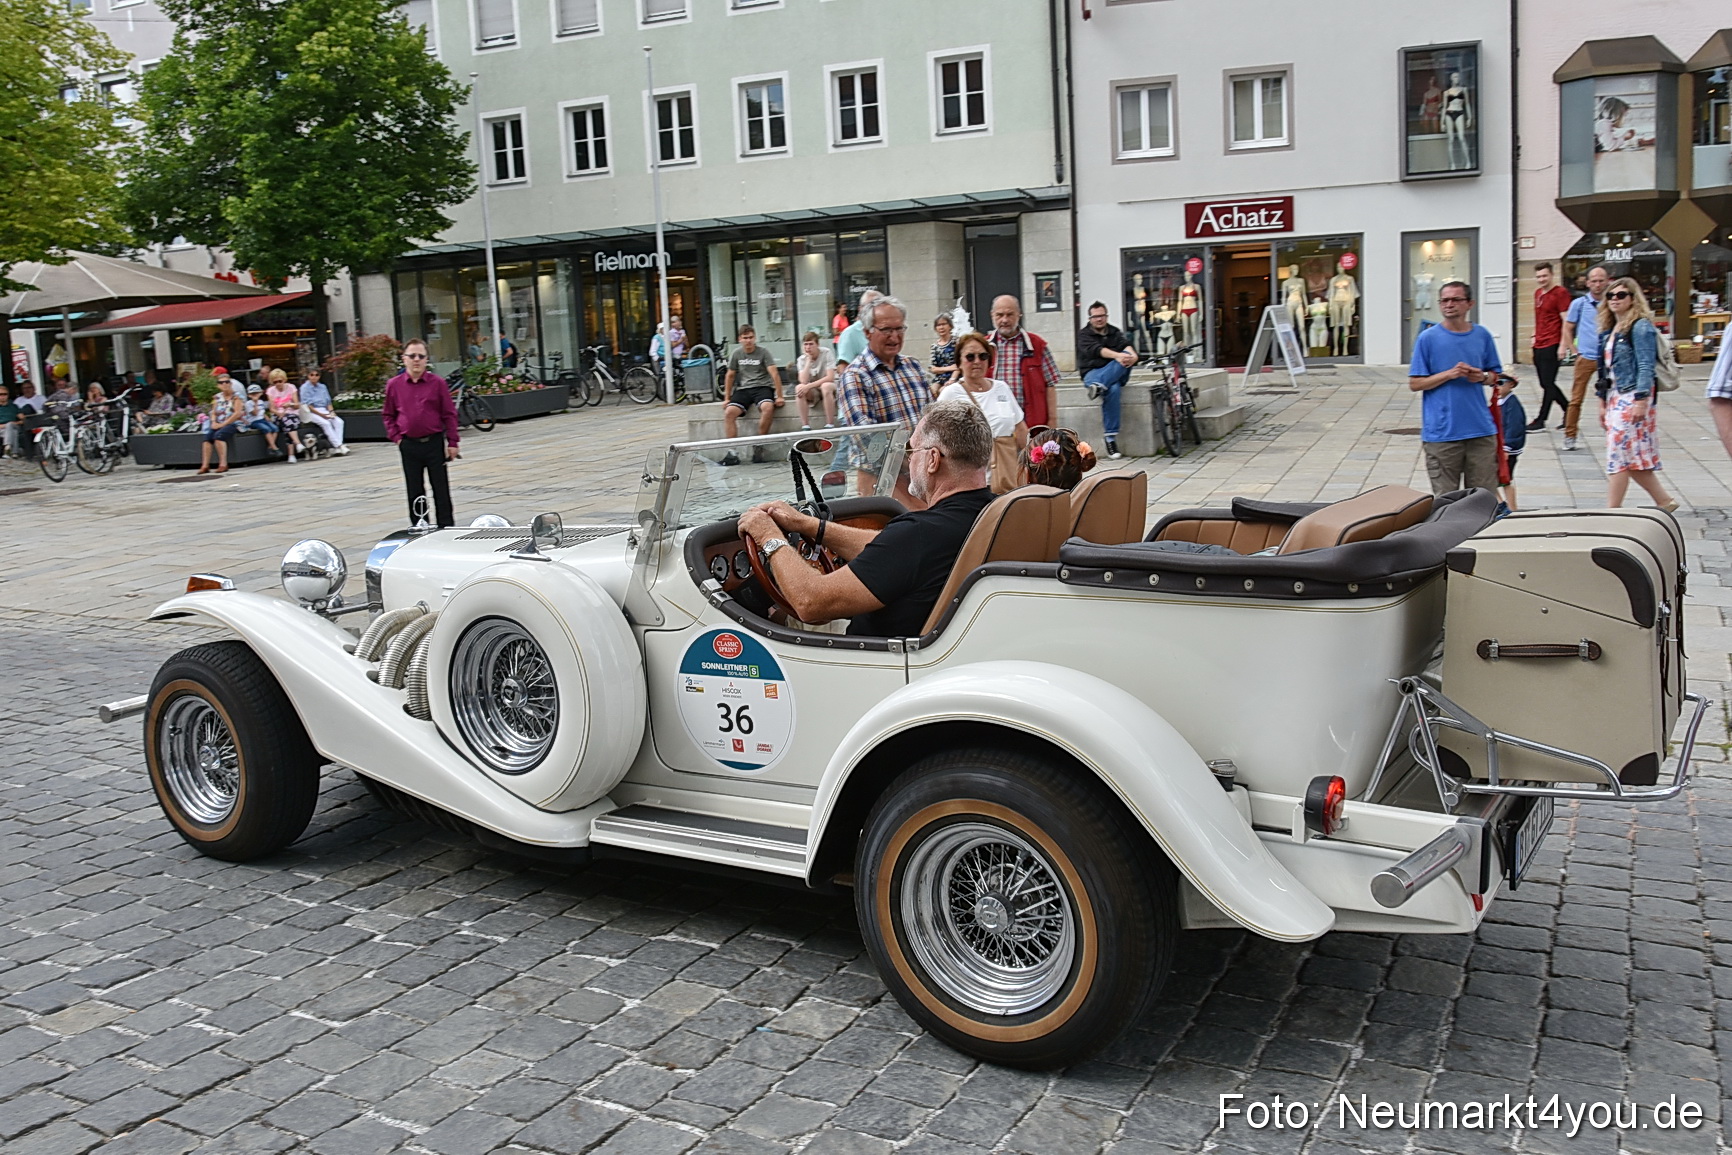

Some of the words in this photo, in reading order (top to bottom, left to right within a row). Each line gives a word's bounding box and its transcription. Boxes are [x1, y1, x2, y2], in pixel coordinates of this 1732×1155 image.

[1194, 204, 1284, 234] Achatz
[716, 640, 739, 648] CLASSIC
[701, 661, 749, 672] SONNLEITNER
[721, 687, 742, 695] HISCOX
[717, 702, 754, 735] 36
